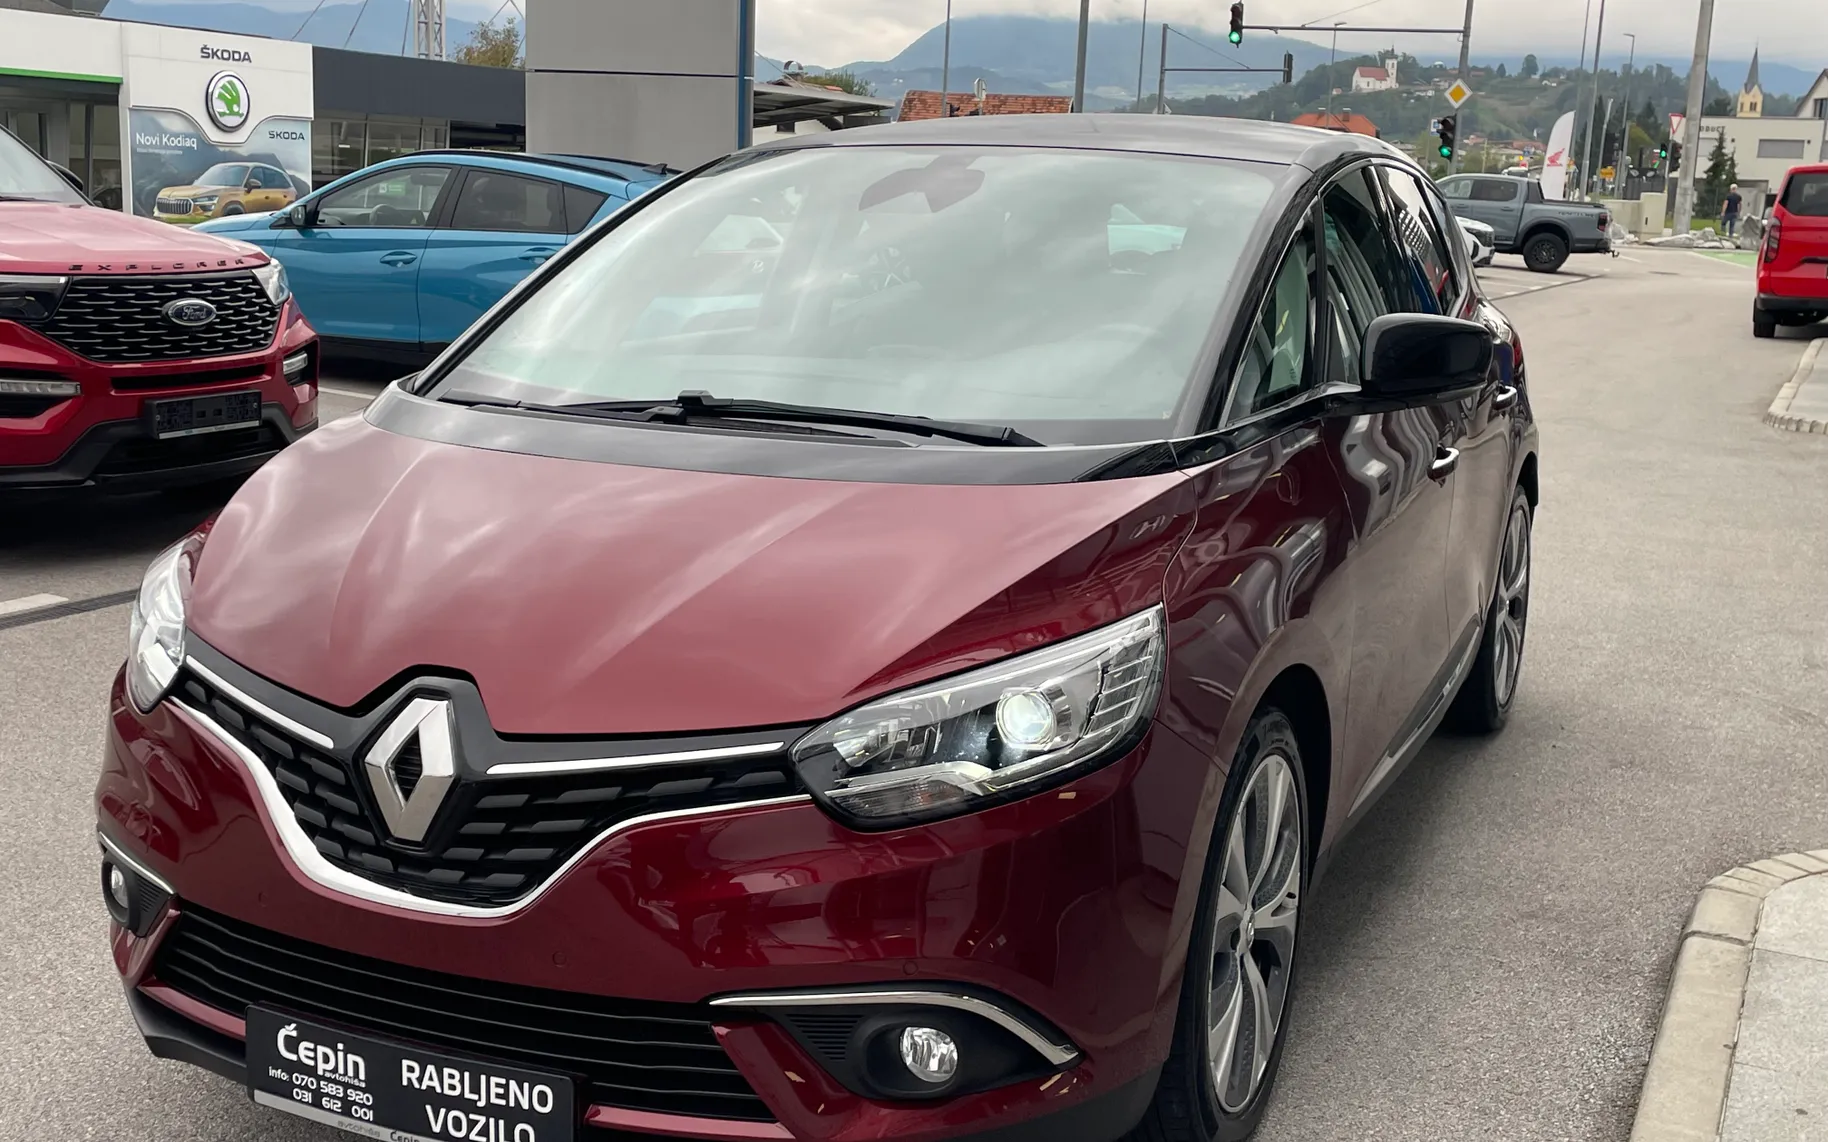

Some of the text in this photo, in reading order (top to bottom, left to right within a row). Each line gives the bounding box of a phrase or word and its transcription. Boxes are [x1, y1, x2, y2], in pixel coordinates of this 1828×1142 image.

[200, 44, 252, 63] ŠKODA
[136, 132, 197, 150] Novi Kodiaq
[68, 258, 244, 271] EXPLORER
[182, 306, 206, 319] Ford
[277, 1023, 366, 1081] Čepin
[268, 1066, 373, 1106] info: 070 583 920
[324, 1071, 366, 1088] avtohiša
[401, 1059, 554, 1114] RABLJENO
[292, 1088, 374, 1121] 031 612 001
[425, 1104, 535, 1142] VOZILO
